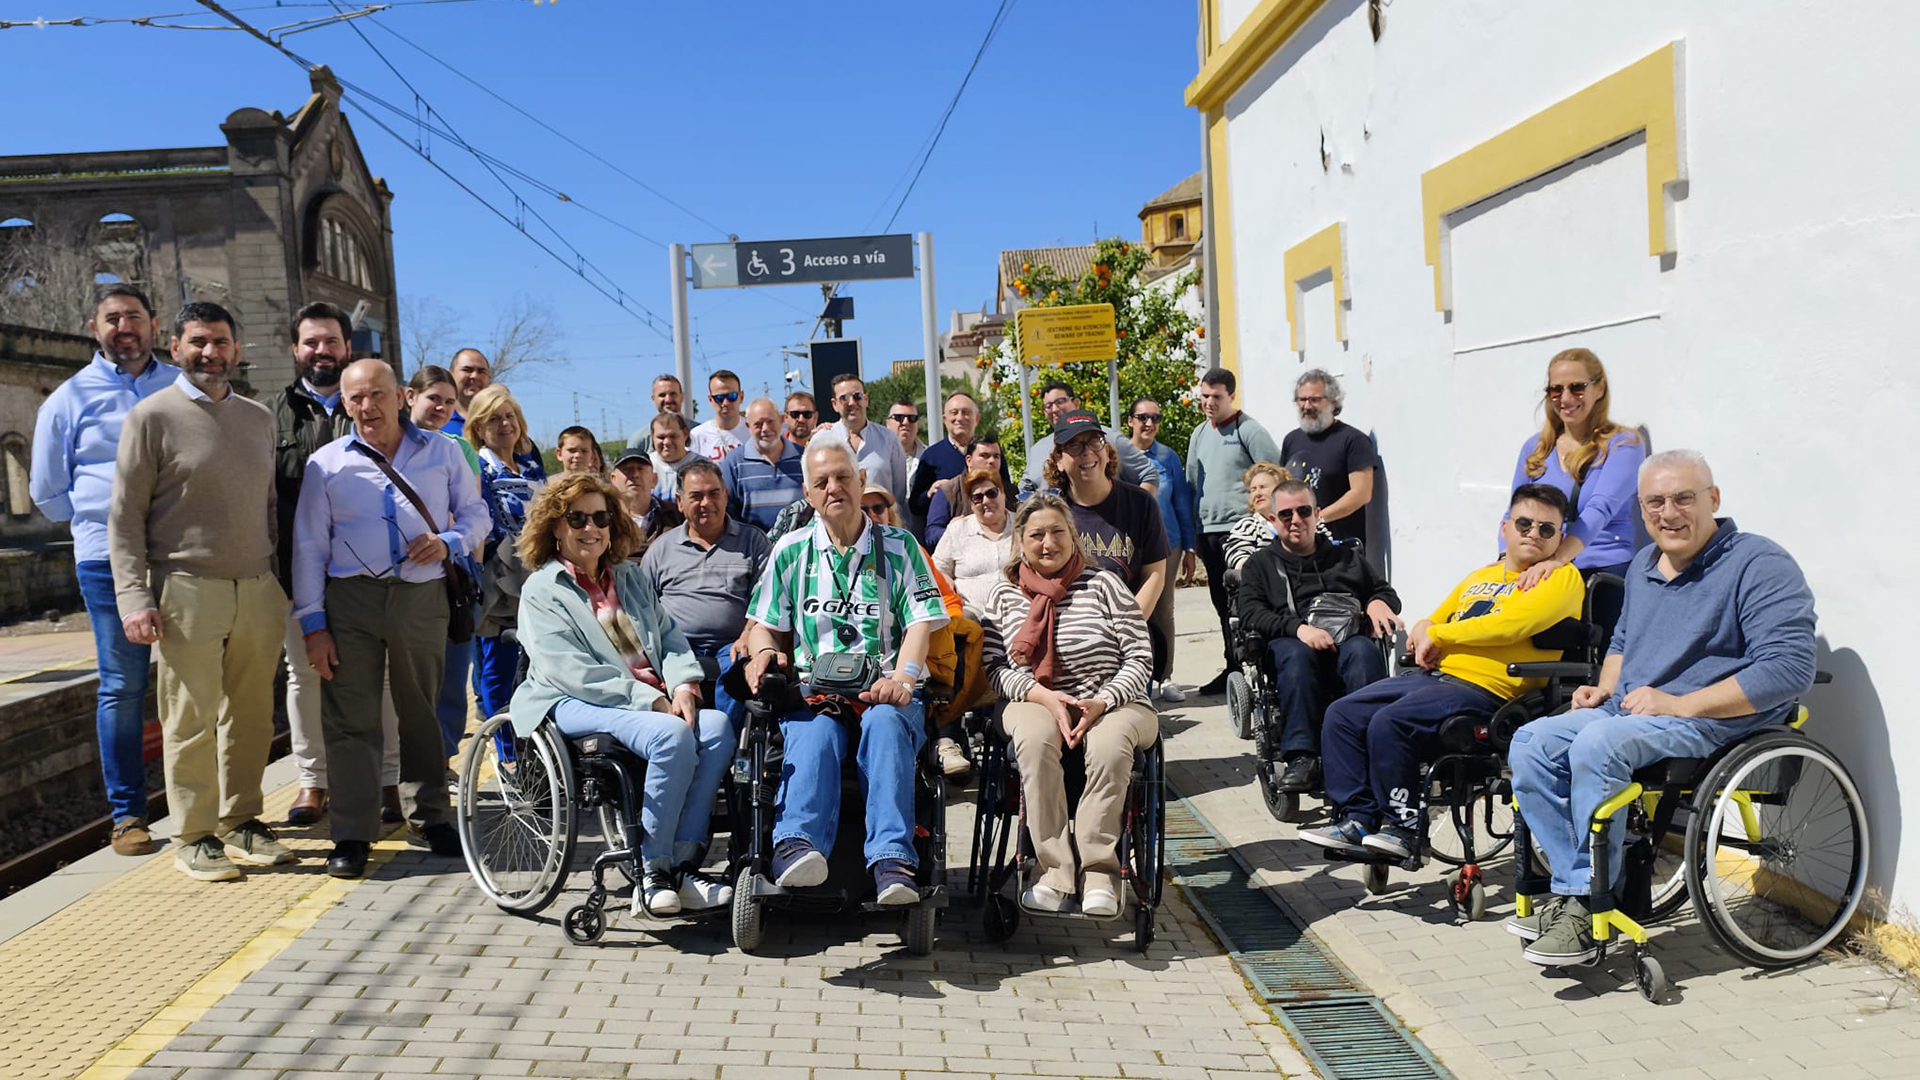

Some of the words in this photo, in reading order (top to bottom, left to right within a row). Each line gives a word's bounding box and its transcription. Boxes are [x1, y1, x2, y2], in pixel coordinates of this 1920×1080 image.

[779, 248, 796, 275] 3
[804, 254, 848, 267] Acceso
[853, 254, 861, 264] a
[865, 250, 886, 264] vía
[822, 600, 880, 616] GREE
